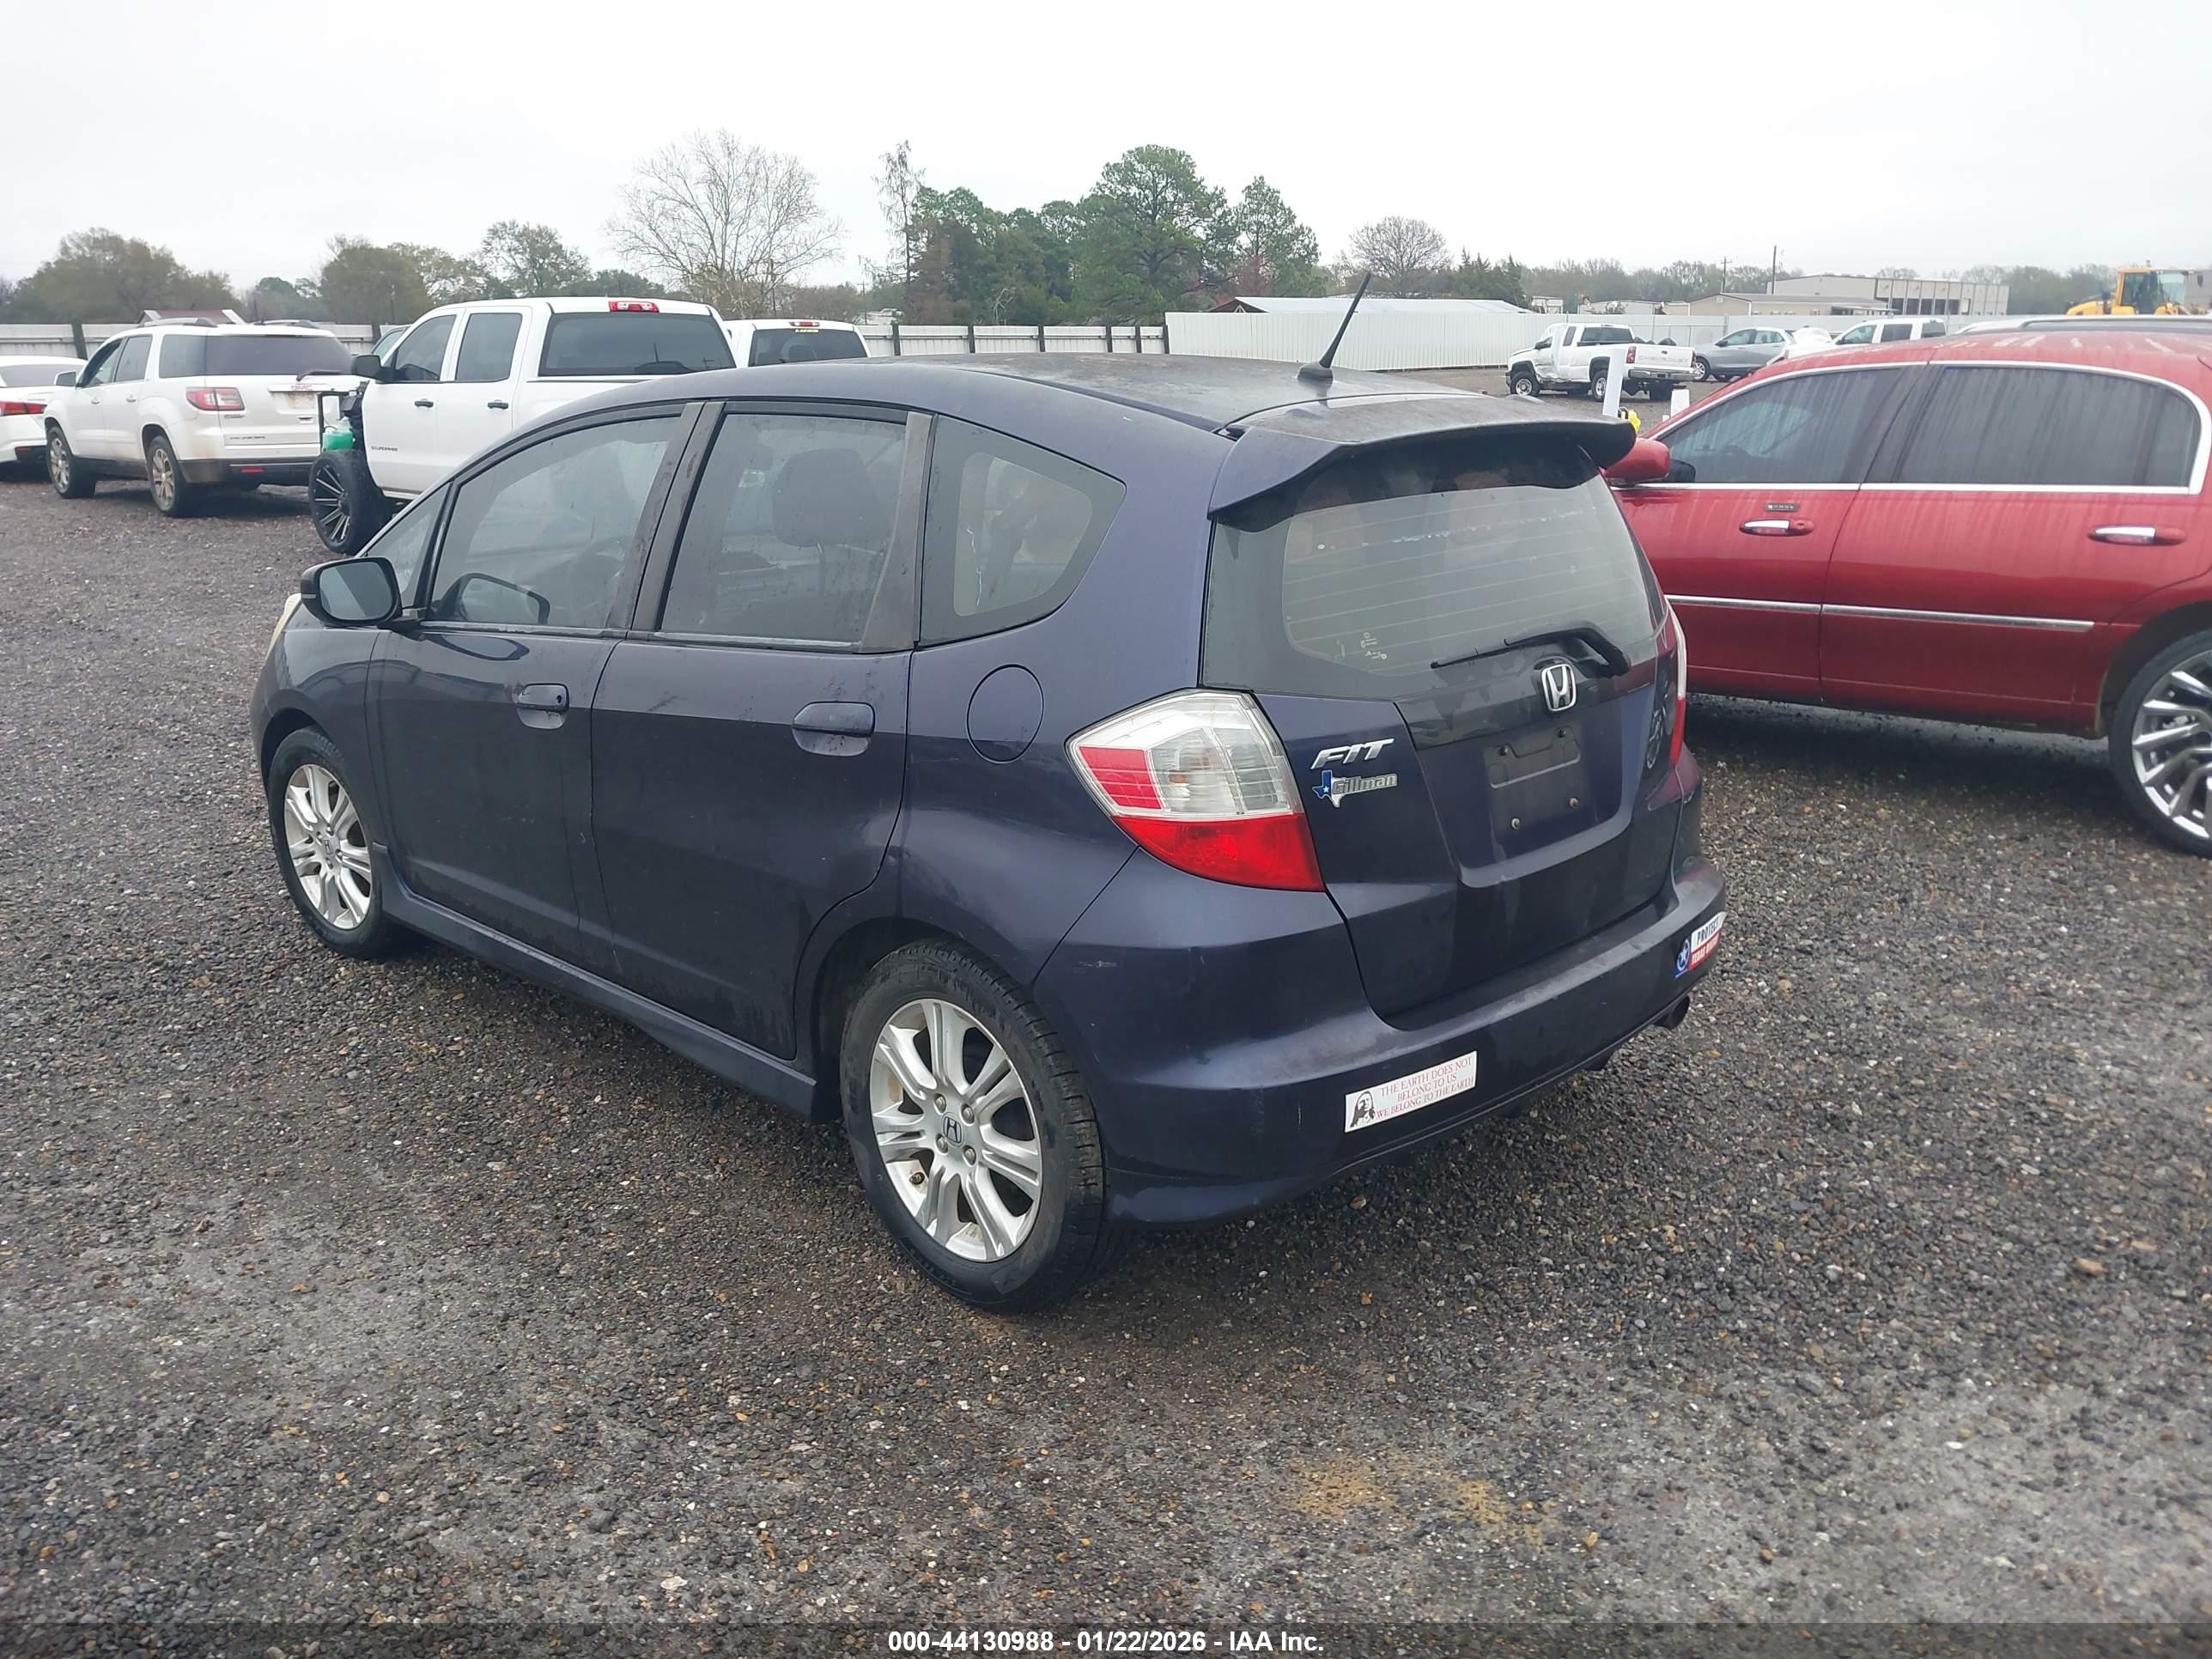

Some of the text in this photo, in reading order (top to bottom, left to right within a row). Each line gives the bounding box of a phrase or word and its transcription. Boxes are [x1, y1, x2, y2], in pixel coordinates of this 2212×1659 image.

[1310, 738, 1395, 769] FIT
[1333, 774, 1397, 794] Gillman
[1381, 1057, 1472, 1097] THE EARTH DOES NOT
[1397, 1073, 1458, 1102] BELONG TO US
[1376, 1077, 1474, 1119] WE BELONG TO THE EARTH
